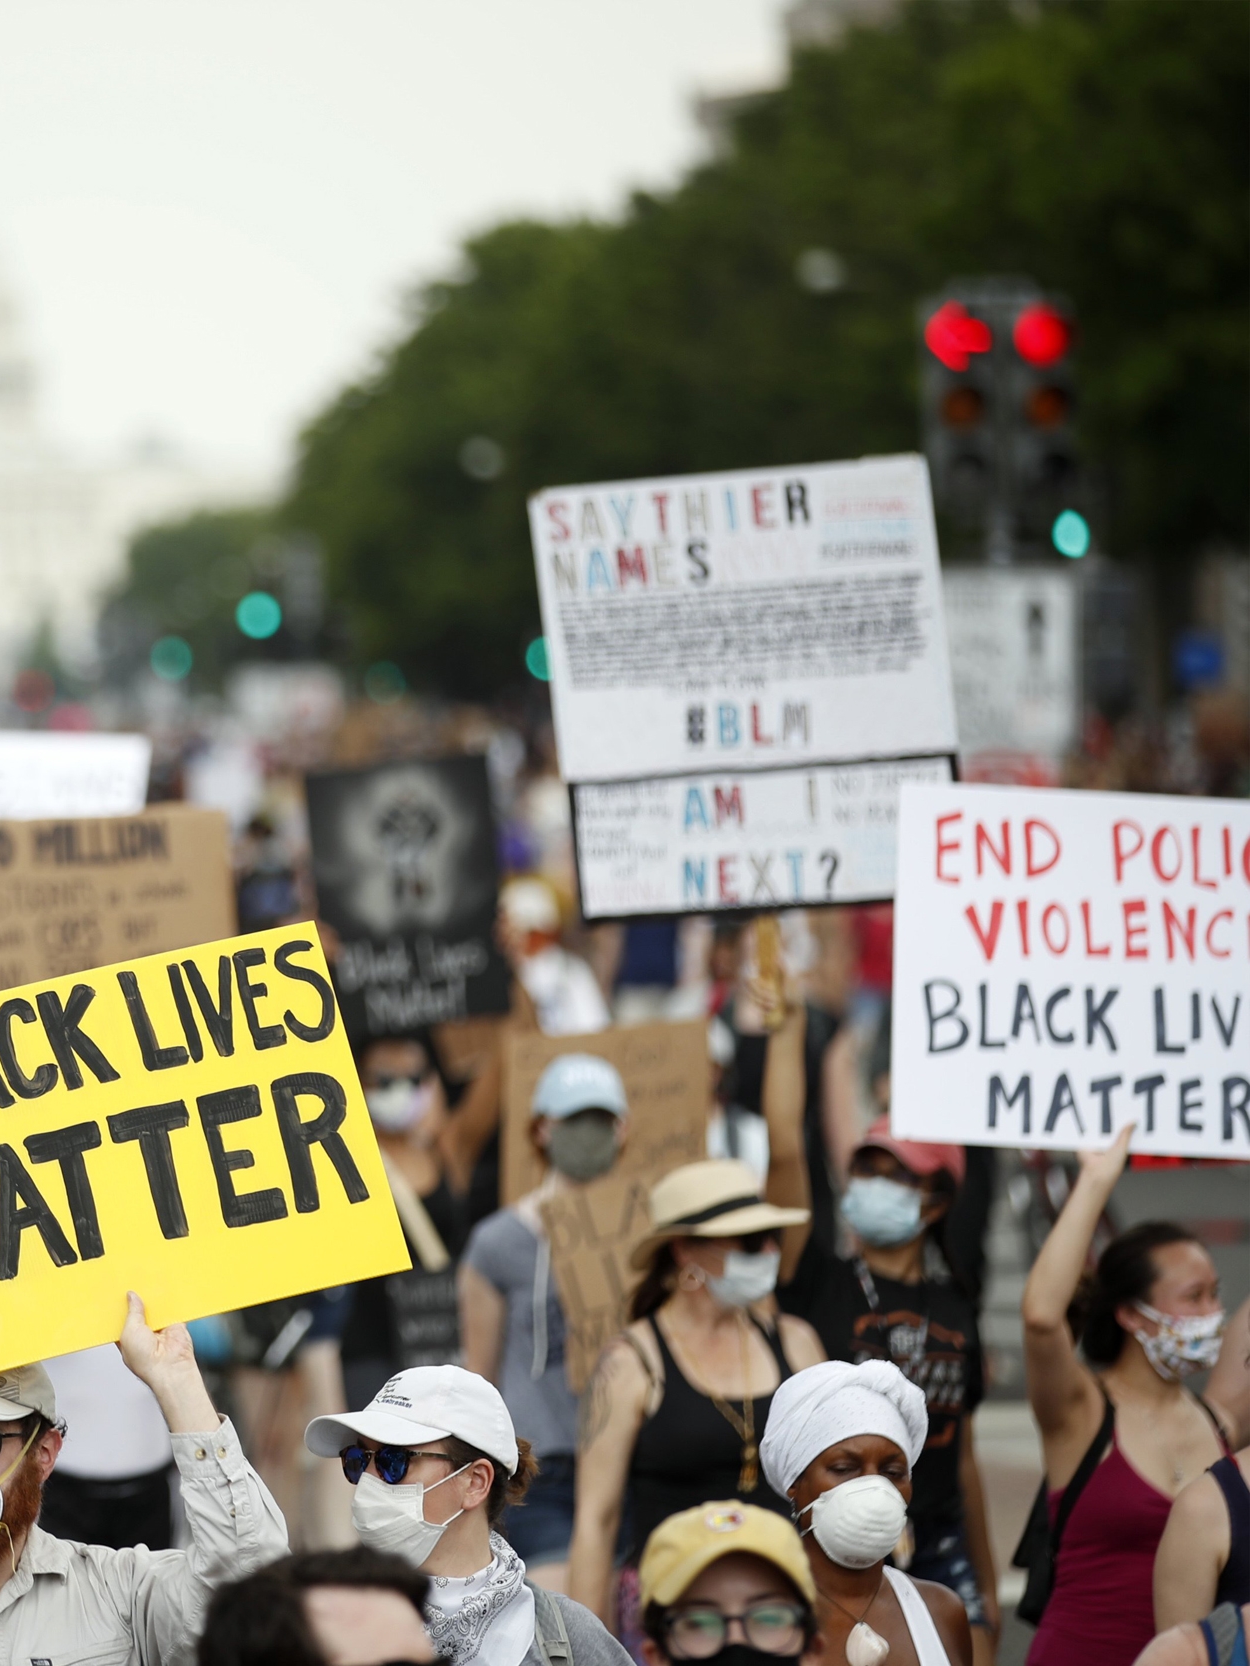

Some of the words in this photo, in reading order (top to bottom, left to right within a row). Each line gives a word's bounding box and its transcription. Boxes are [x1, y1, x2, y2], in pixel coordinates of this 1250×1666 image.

[552, 542, 712, 594] NAMES
[686, 702, 812, 746] #BLM
[683, 784, 746, 834] AM
[32, 820, 171, 866] MILLION
[936, 811, 1062, 884] END
[1112, 820, 1250, 891] POLI
[683, 848, 841, 904] NEXT?
[964, 900, 1250, 963] VIOLENC
[117, 941, 335, 1071] LIVES
[923, 978, 1119, 1054] BLACK
[987, 1071, 1250, 1141] MATTER
